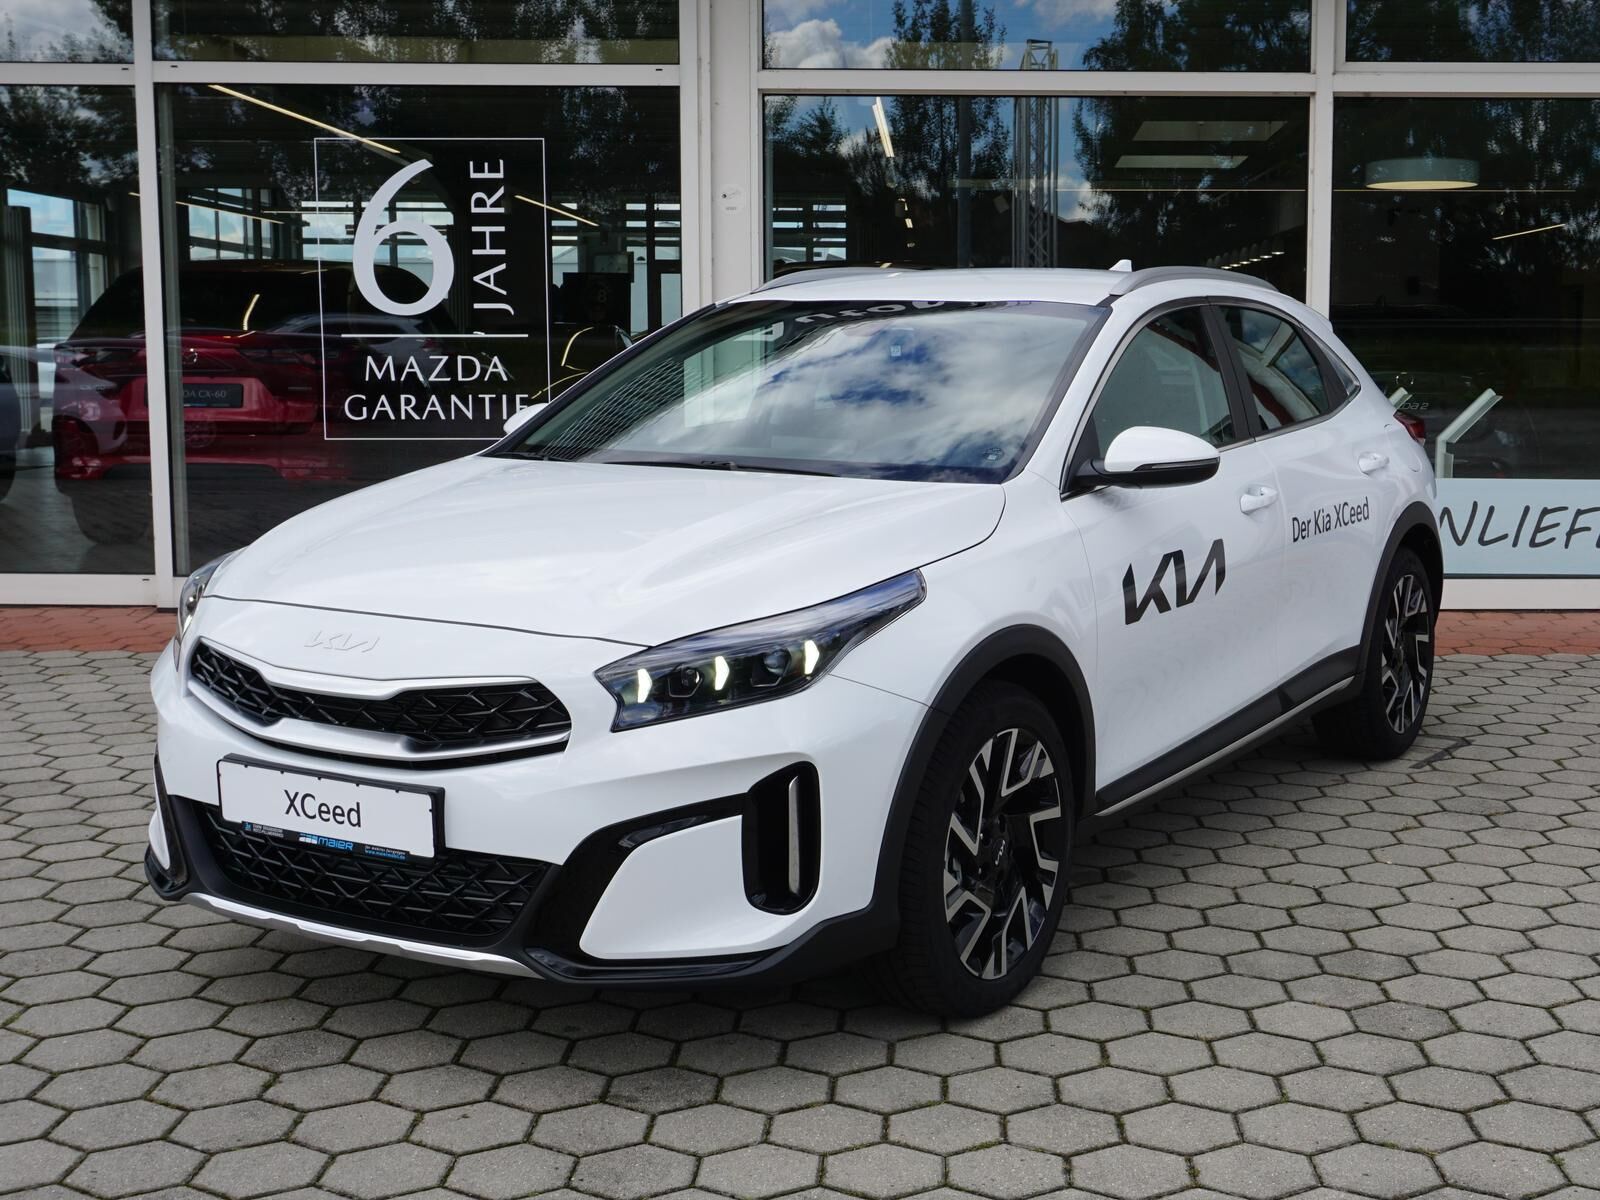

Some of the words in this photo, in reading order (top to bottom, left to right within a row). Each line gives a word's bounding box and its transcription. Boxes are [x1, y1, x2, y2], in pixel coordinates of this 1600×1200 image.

[352, 158, 455, 316] 6
[469, 158, 515, 316] JAHRE
[364, 355, 508, 382] MAZDA
[1292, 516, 1312, 543] Der
[1313, 508, 1332, 534] Kia
[1334, 496, 1370, 530] XCeed
[1439, 500, 1600, 550] NLIEF
[1122, 538, 1226, 626] KIA
[283, 789, 362, 828] XCeed
